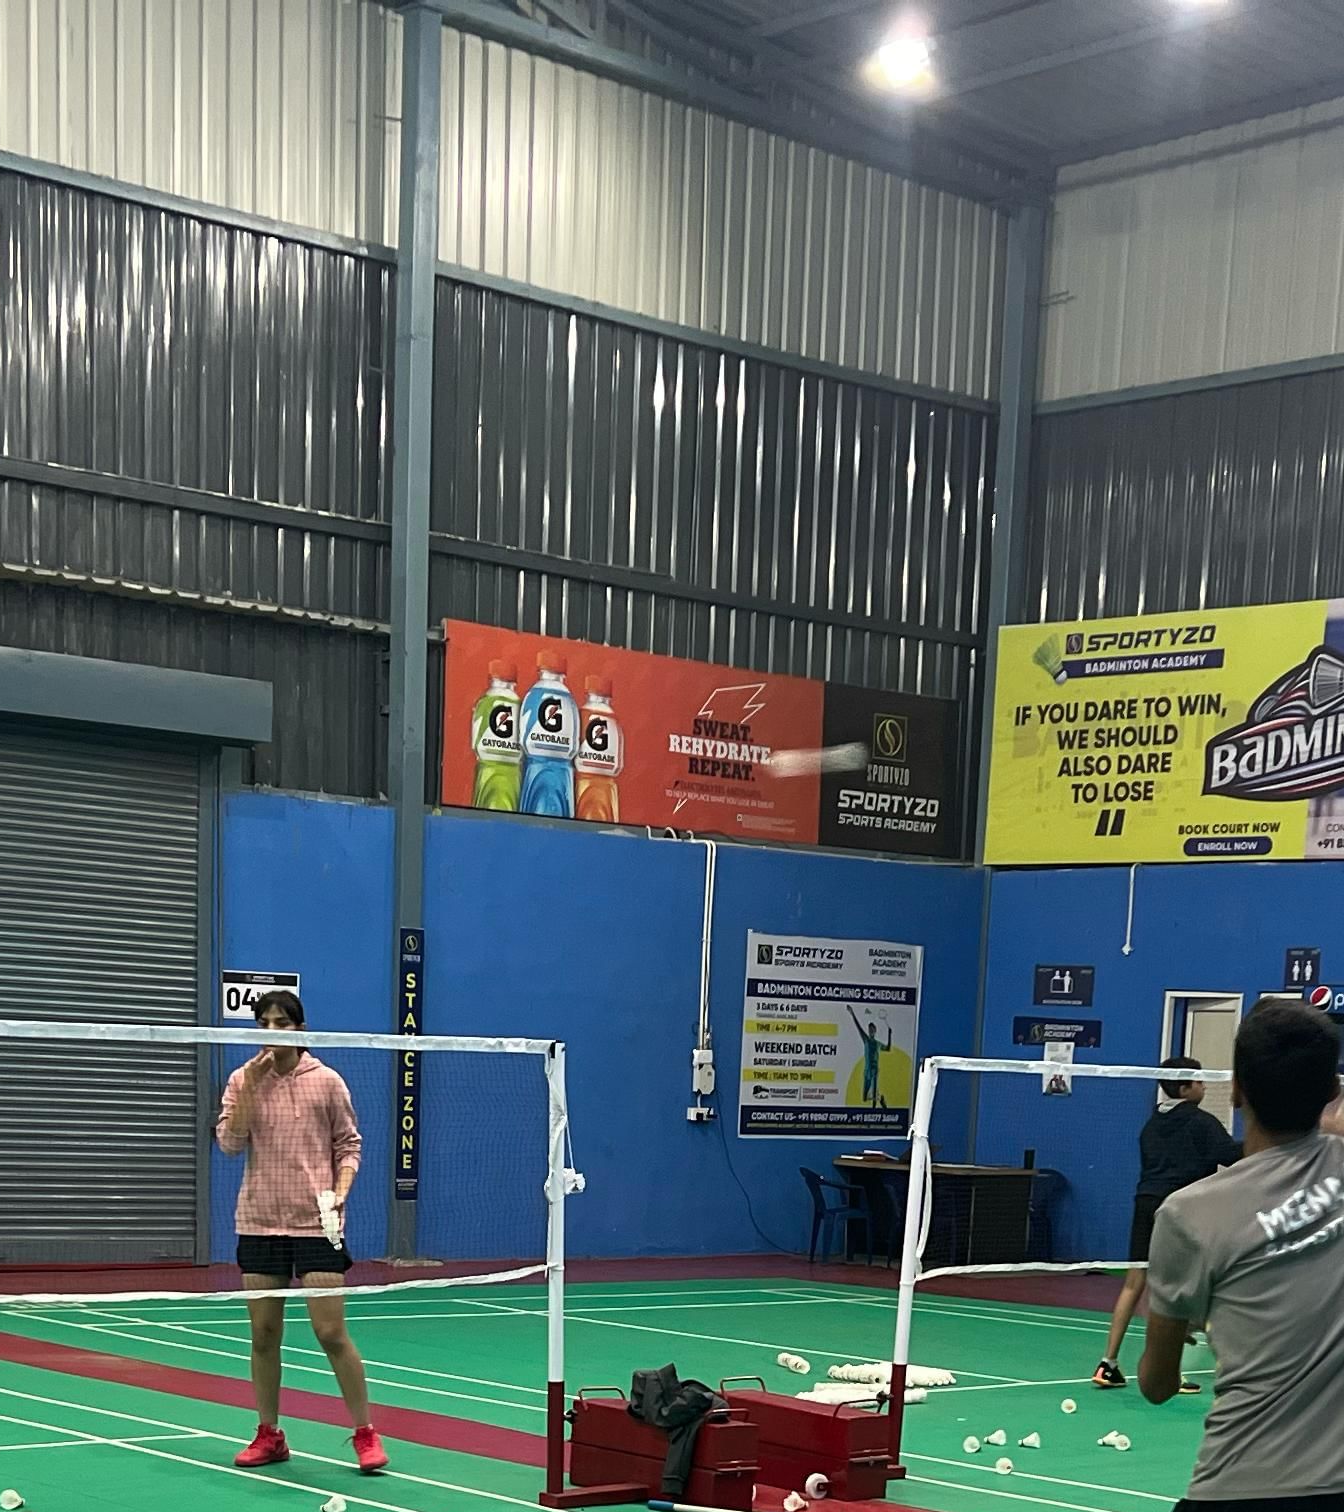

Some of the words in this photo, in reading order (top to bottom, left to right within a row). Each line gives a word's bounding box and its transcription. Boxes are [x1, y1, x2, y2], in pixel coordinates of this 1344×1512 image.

[1086, 624, 1217, 653] SPORTYZO
[1084, 656, 1150, 674] BADMINTON
[1152, 653, 1208, 670] ACADEMY
[1015, 704, 1033, 727] IF
[1037, 701, 1079, 725] YOU
[1083, 698, 1139, 723] DARE
[1142, 696, 1173, 719] TO
[1177, 693, 1227, 718] WIN,
[692, 718, 754, 742] SWEAT.
[1057, 727, 1089, 751] WE
[1094, 724, 1179, 749] SHOULD
[668, 733, 775, 766] REHYDRATE.
[688, 757, 756, 782] REPEAT.
[867, 763, 911, 786] SPORTYZO
[1057, 755, 1112, 777] ALSO
[1117, 752, 1173, 775] DARE
[837, 789, 940, 817] SPORTYZO
[1071, 782, 1099, 804] TO
[1103, 780, 1155, 803] LOSE
[837, 812, 883, 829] SPORTS
[883, 818, 937, 834] ACADEMY
[1178, 823, 1209, 836] BOOK
[1213, 822, 1250, 835] COURT
[1253, 821, 1281, 834] NOW
[1197, 841, 1232, 853] ENROLL
[1234, 840, 1259, 851] NOW
[775, 945, 844, 960] SPORTYZO
[226, 987, 256, 1011] 04
[757, 982, 812, 998] BADMINTON
[813, 985, 862, 1000] COACHING
[862, 989, 907, 1001] SCHEDULE
[403, 973, 417, 1087] STACE
[755, 1041, 803, 1055] WEEKEND
[805, 1044, 837, 1056] BATCH
[402, 1096, 415, 1170] ZONE
